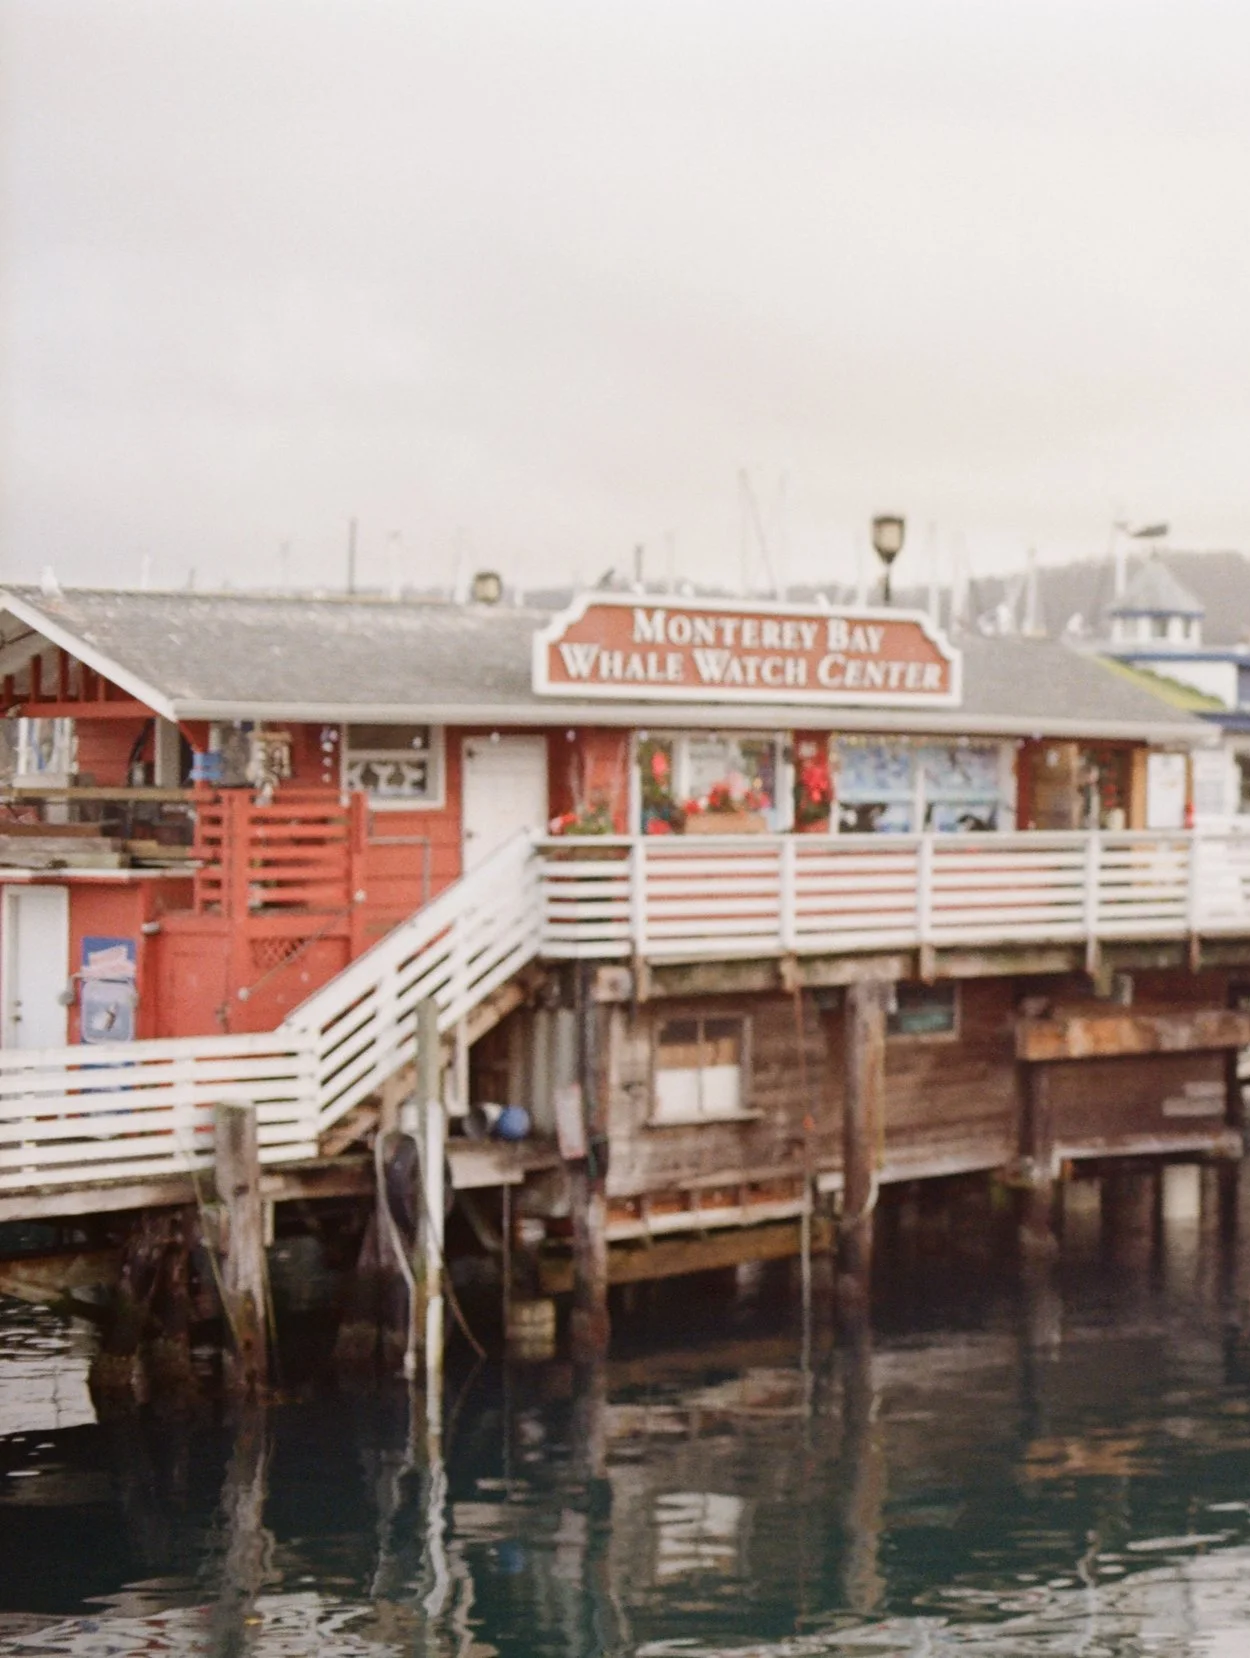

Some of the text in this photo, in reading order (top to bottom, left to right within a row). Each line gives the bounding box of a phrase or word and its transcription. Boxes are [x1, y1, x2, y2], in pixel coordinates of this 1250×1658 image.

[632, 607, 885, 653] MONTEREY BAY
[559, 642, 943, 690] WHALE WATCH CENTER
